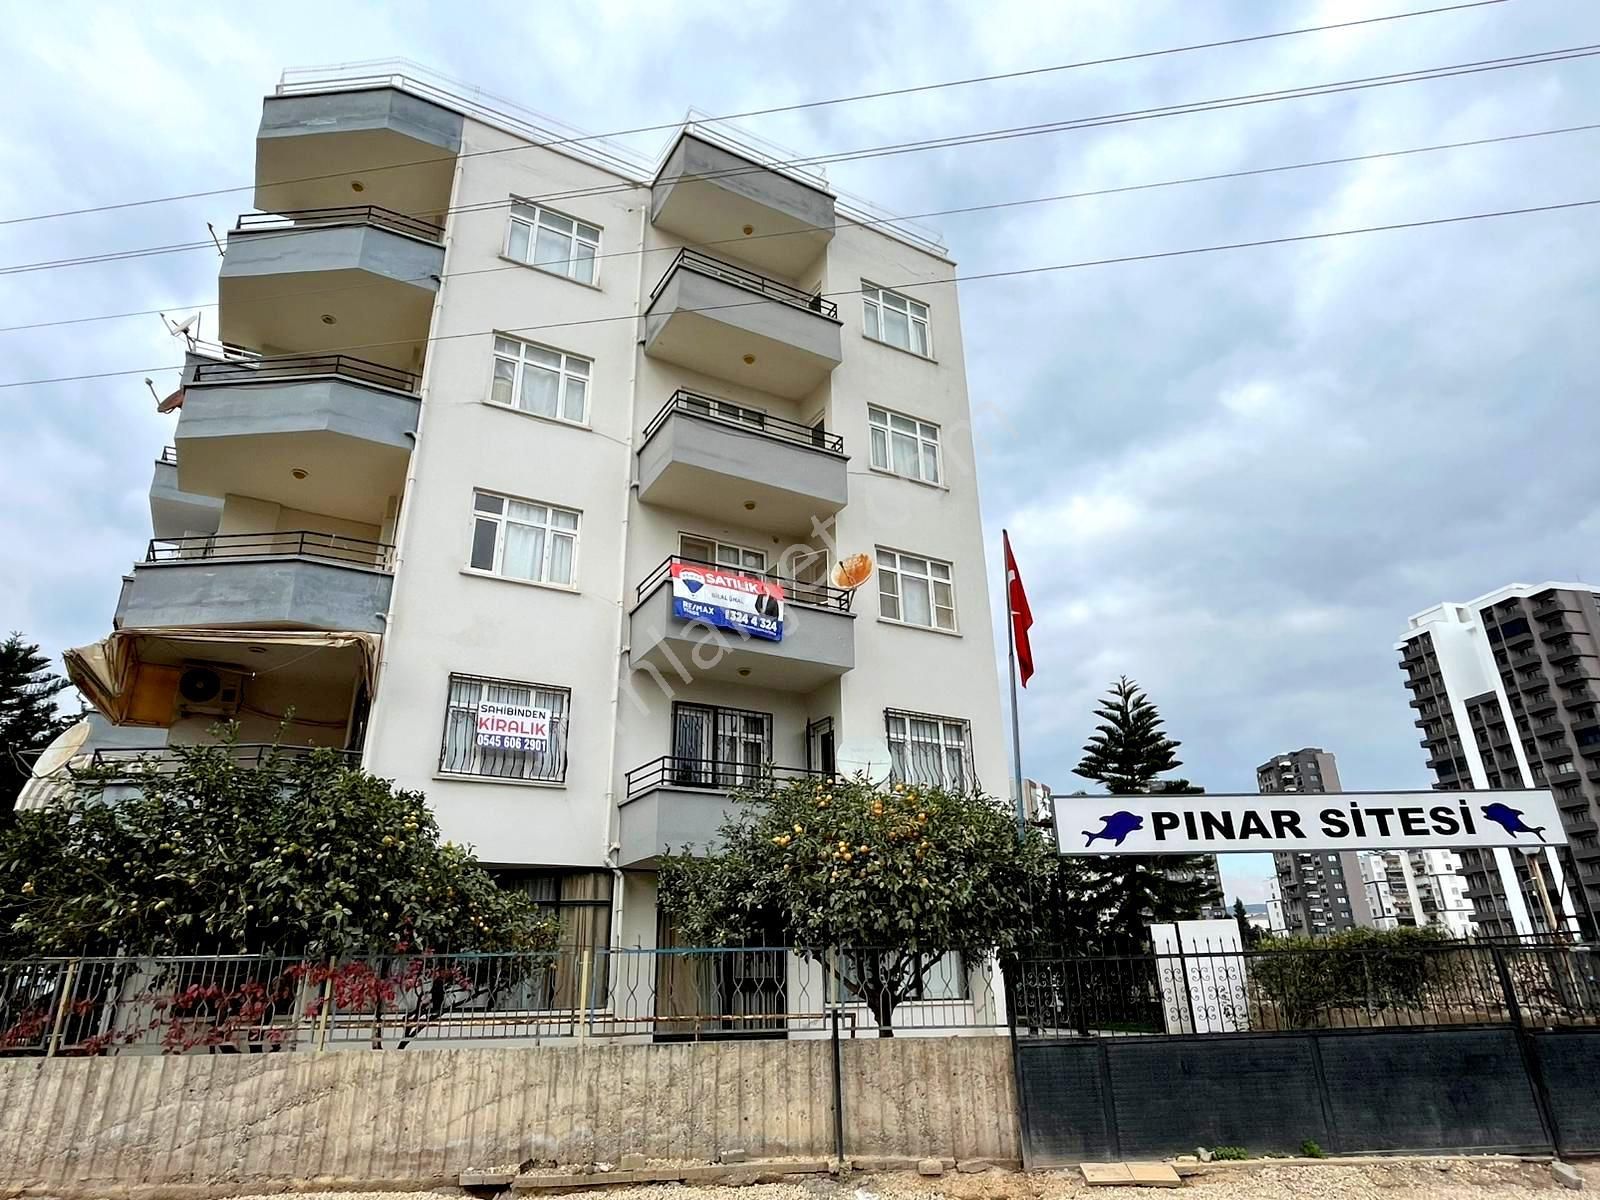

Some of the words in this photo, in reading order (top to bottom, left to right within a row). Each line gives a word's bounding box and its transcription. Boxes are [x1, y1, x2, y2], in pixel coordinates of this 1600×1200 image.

[706, 574, 758, 593] SATILIK
[683, 600, 714, 615] RE/MAX
[750, 615, 757, 626] 4
[760, 618, 777, 632] 324
[479, 715, 546, 736] KİRALIK
[477, 735, 501, 747] 0545
[503, 736, 522, 748] 606
[524, 738, 546, 752] 2901
[1151, 810, 1307, 841] PINAR
[1319, 799, 1477, 838] SİTESİ
